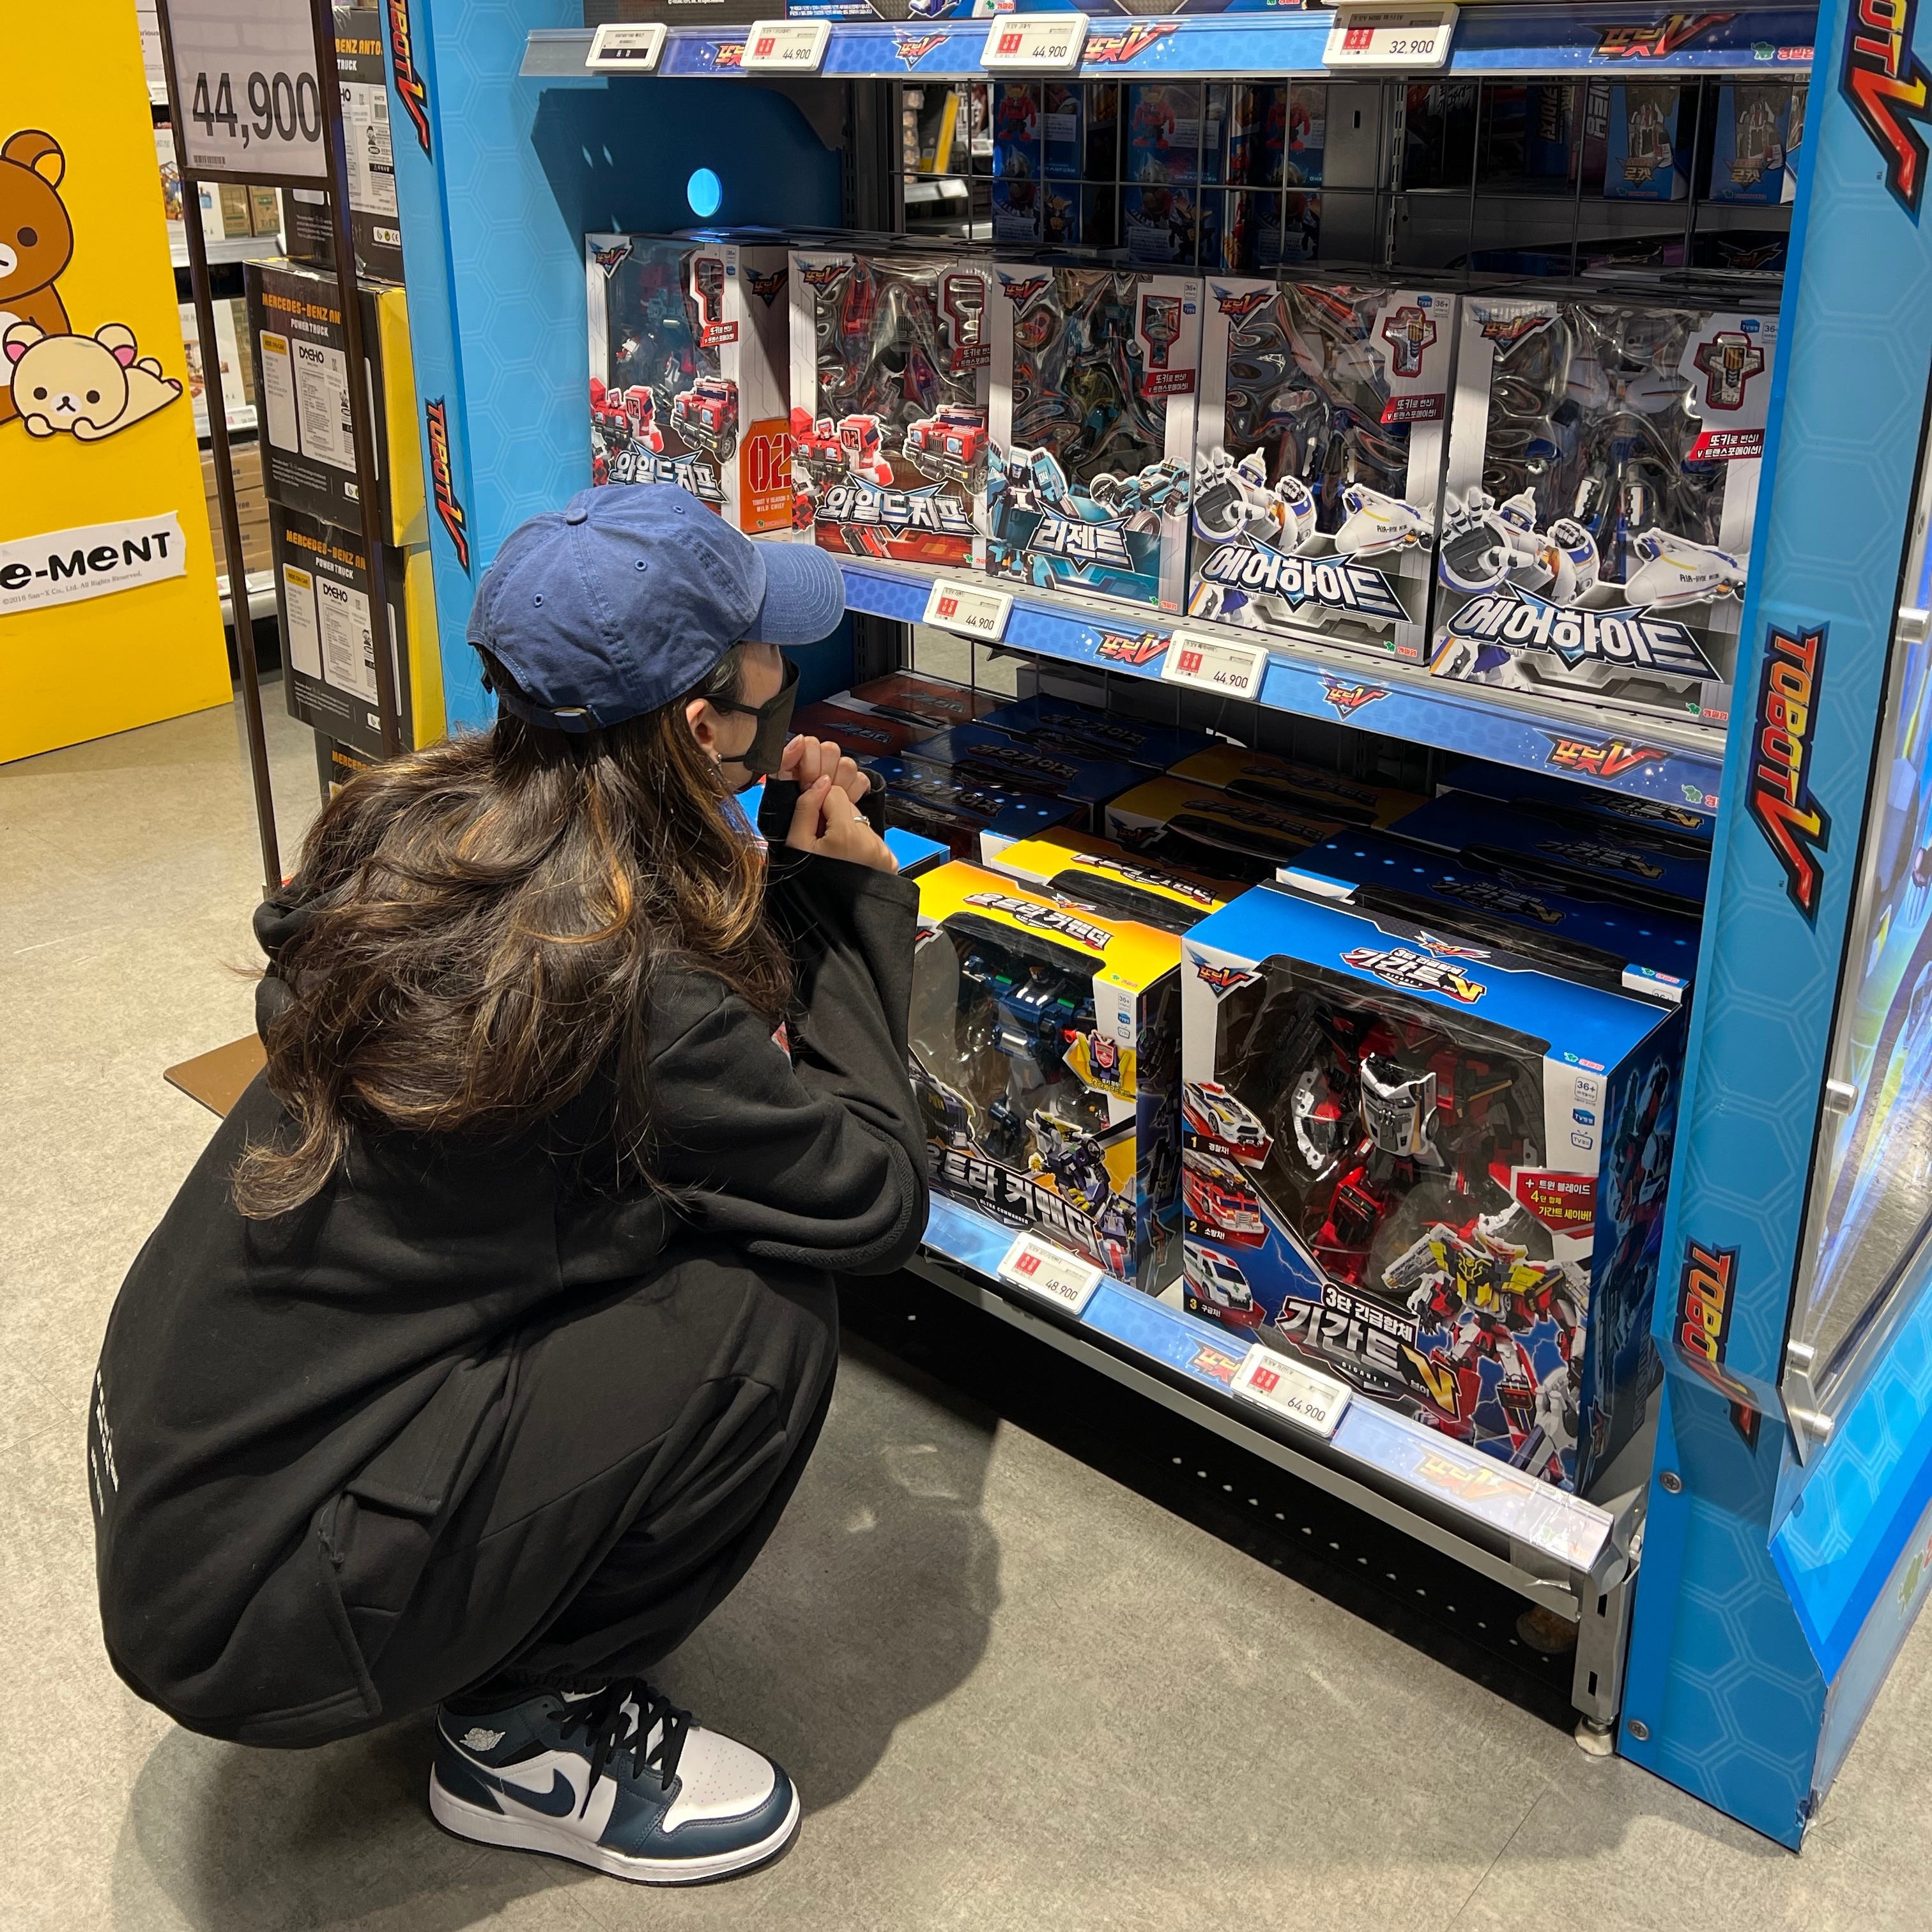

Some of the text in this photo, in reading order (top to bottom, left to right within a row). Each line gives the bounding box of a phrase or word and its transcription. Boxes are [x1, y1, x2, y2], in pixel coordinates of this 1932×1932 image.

[1085, 25, 1180, 62] 또봇V
[1598, 13, 1735, 56] 또봇V
[359, 40, 383, 56] ANTO
[783, 49, 811, 59] 44,900
[900, 35, 951, 57] 또봇V
[1032, 46, 1066, 58] 44,900
[1389, 40, 1434, 54] 32,900
[192, 72, 320, 148] 44,900
[804, 266, 850, 285] 또봇V
[1004, 280, 1047, 299] 또봇V
[1219, 295, 1271, 314] 또봇V
[1156, 374, 1173, 383] 또키로
[1393, 409, 1437, 420] 트랜스포메이션!
[1397, 398, 1434, 410] 또키로 변신!
[1709, 433, 1759, 447] 또키로 변신!
[428, 403, 452, 507] TOBOT
[1697, 445, 1761, 458] V 트랜스포메이션!
[749, 434, 792, 493] 02
[615, 452, 720, 500] 와일드치프
[825, 486, 975, 533] 와일드치프
[1033, 516, 1126, 562] 리젠트
[1206, 548, 1393, 606] 에어하이드
[965, 615, 994, 630] 44,900
[1459, 597, 1699, 663] 에어하이드
[1103, 634, 1170, 663] 또봇V
[1214, 671, 1248, 688] 44,900
[1329, 687, 1384, 707] 또봇V
[1758, 635, 1819, 806] TOBOT
[1554, 739, 1670, 776] 또봇V
[1043, 910, 1114, 950] 커맨더
[1199, 965, 1250, 989] 또봇V
[1344, 949, 1446, 988] 기간트
[1119, 995, 1130, 1004] 36+
[1577, 1081, 1596, 1093] 36+
[1191, 1136, 1229, 1155] 1 경찰차!
[1538, 1180, 1556, 1190] 트윈
[1557, 1182, 1591, 1195] 블레이드
[979, 1199, 996, 1210] ULTRA
[1531, 1191, 1562, 1206] 4단 합체
[1005, 1176, 1100, 1262] 커맨더
[1538, 1205, 1592, 1222] 기간트 세이버!
[1190, 1220, 1225, 1240] 2 소방차!
[1046, 1279, 1078, 1301] 48,900
[1190, 1297, 1222, 1318] 3 구급차!
[1325, 1288, 1413, 1342] 3단 긴급합체
[1193, 1346, 1241, 1383] 또봇
[1281, 1302, 1455, 1415] 기간트 V
[1342, 1361, 1378, 1383] GIGANT
[1410, 1379, 1430, 1398] 브이
[1287, 1397, 1326, 1422] 64,900
[1414, 1453, 1531, 1500] 또봇V
